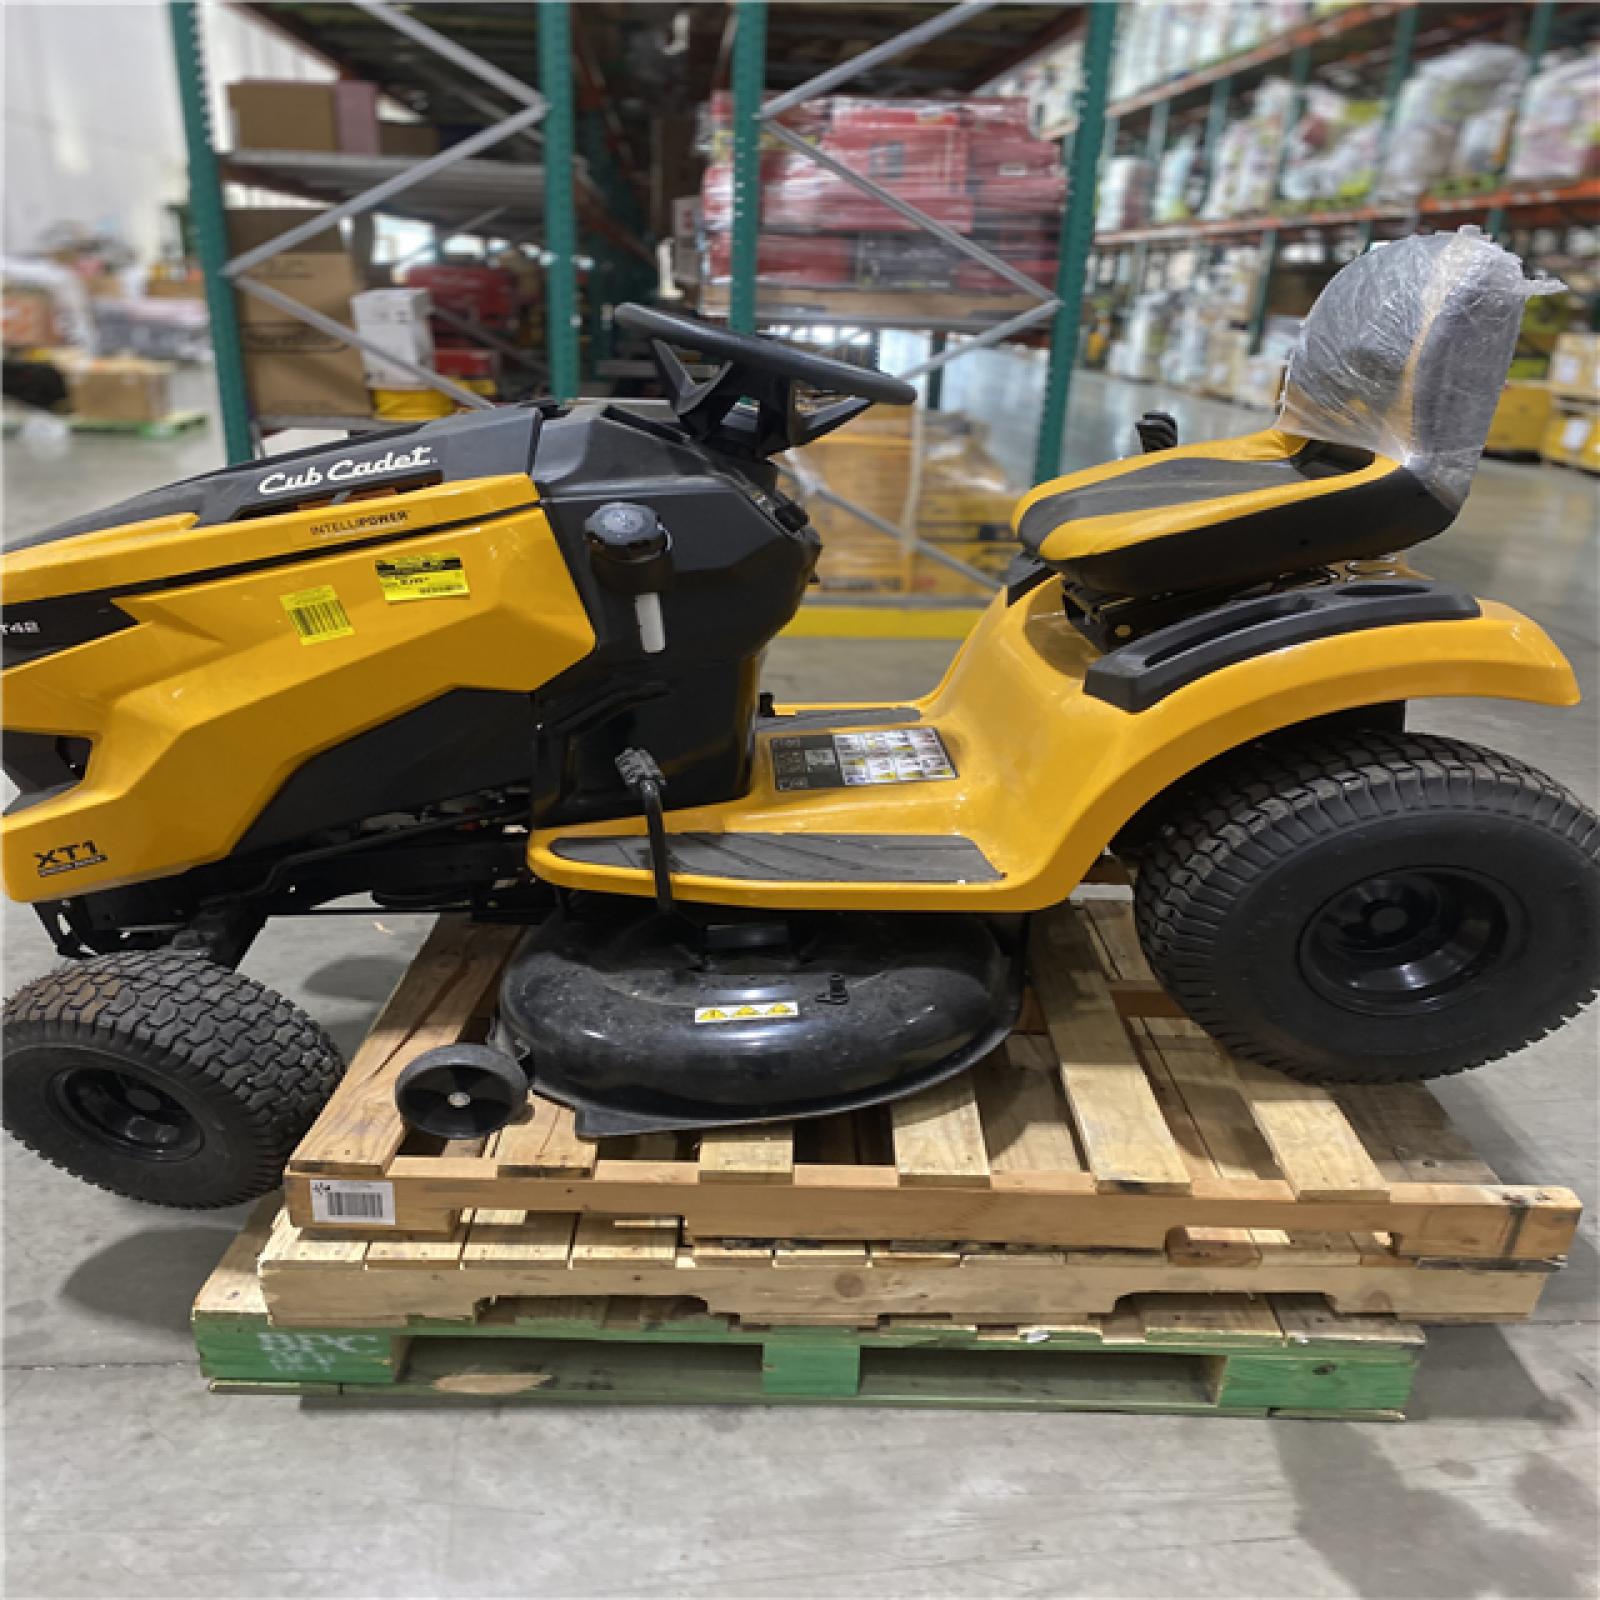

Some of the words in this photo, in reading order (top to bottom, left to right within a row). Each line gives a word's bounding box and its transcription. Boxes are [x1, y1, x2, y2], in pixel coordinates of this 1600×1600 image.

[258, 466, 323, 494] Cub
[327, 446, 432, 480] Cadet
[310, 510, 408, 535] INTELLIPOWER
[34, 839, 98, 869] XT1
